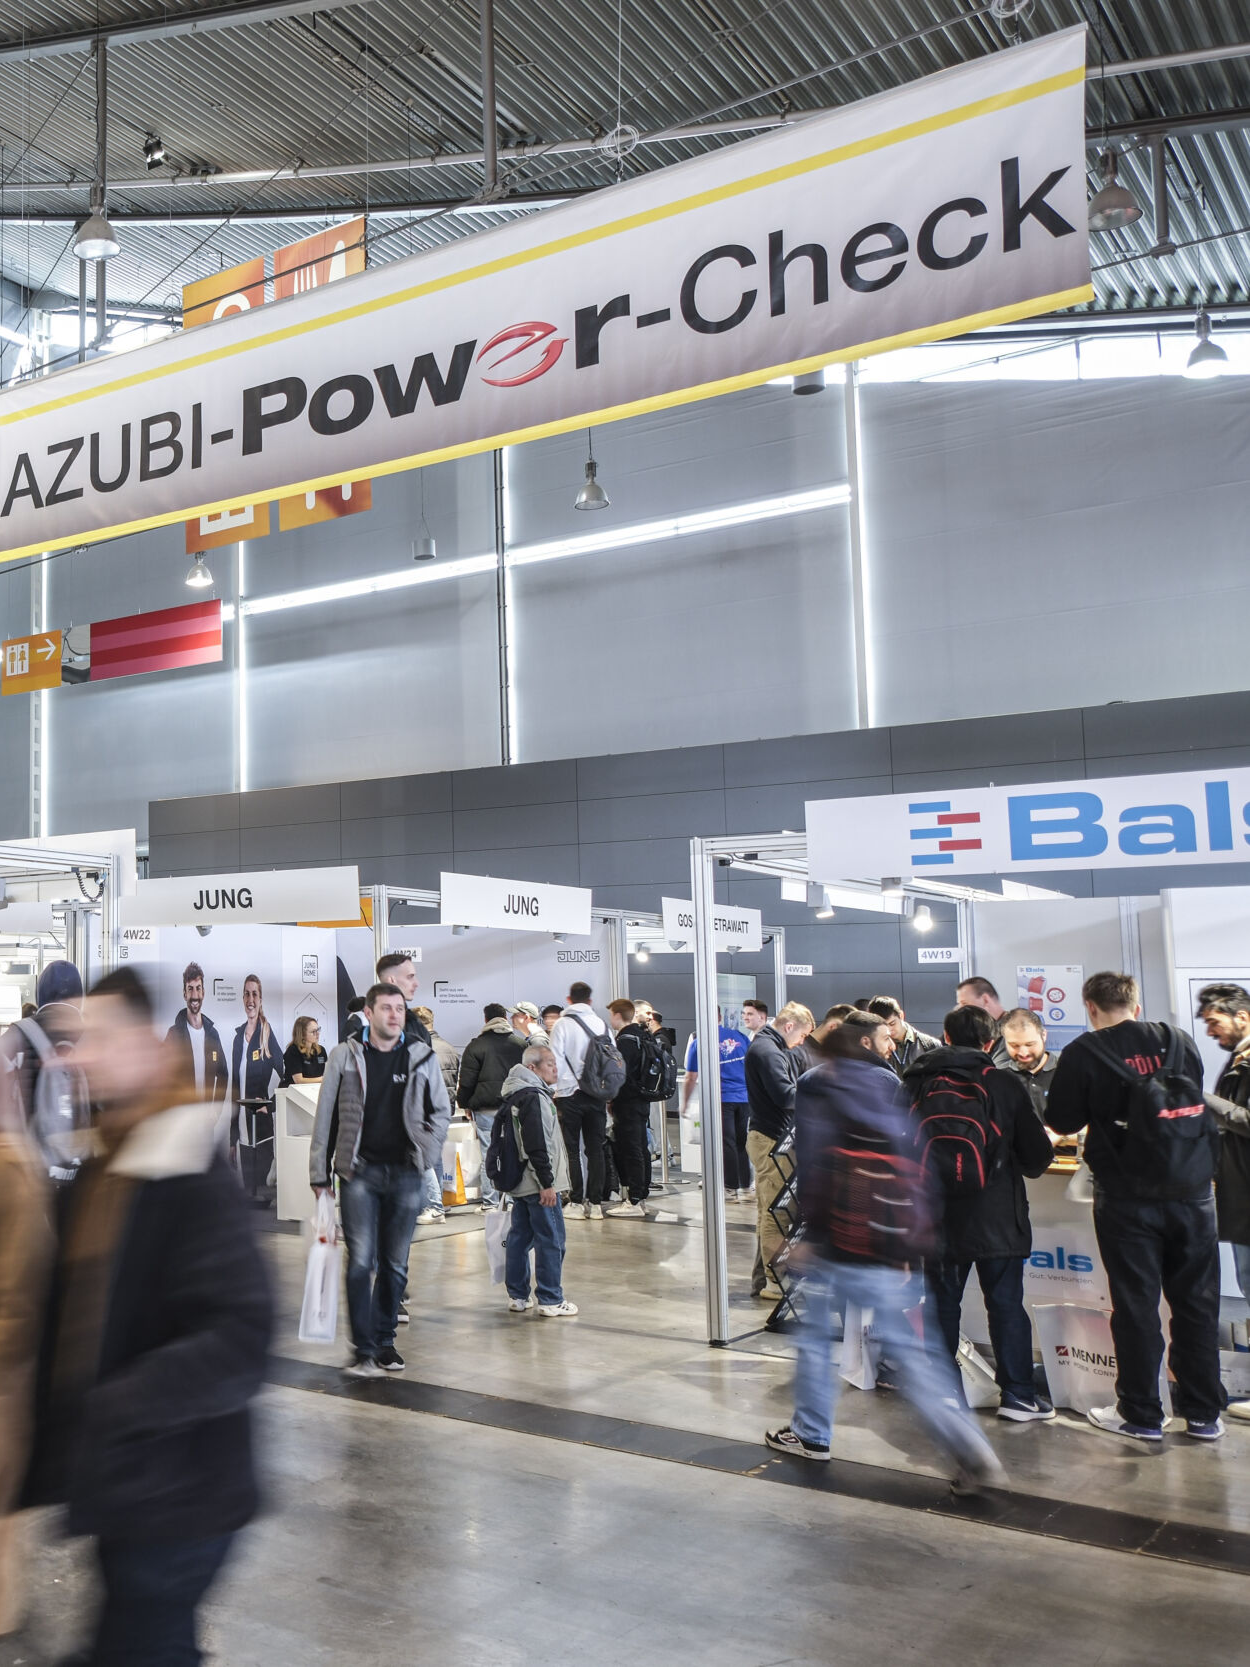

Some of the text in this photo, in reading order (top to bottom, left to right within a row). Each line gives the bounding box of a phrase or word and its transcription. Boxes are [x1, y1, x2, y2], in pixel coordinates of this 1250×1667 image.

[1008, 780, 1250, 861] Bal
[193, 887, 253, 911] JUNG
[503, 894, 540, 917] JUNG
[677, 913, 749, 934] GOS ETRAWATT
[123, 929, 151, 940] 4W22
[557, 950, 600, 962] JUNG
[921, 950, 952, 959] 4W19
[787, 966, 809, 974] 4W25
[1023, 1246, 1094, 1273] als
[1071, 1346, 1117, 1368] MENNE
[1093, 1368, 1118, 1379] CONN
